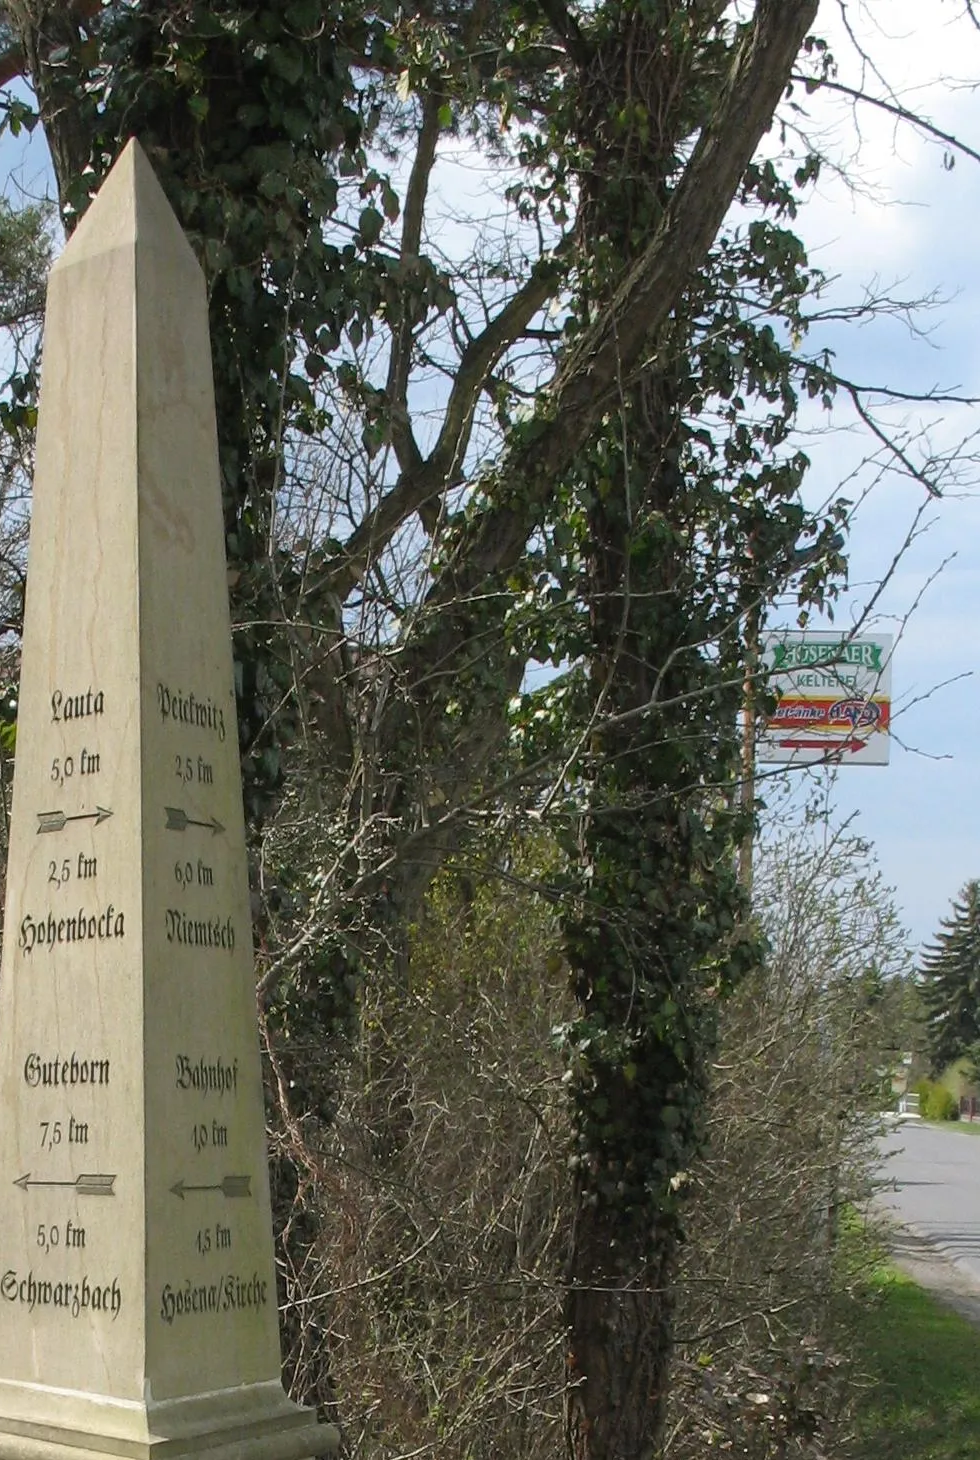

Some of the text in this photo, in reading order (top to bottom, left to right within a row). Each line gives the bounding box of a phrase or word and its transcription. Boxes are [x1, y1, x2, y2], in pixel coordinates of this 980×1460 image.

[50, 686, 105, 724] Lauta
[157, 683, 226, 742] Peickwitz
[51, 747, 101, 788] 5,0 km
[175, 755, 214, 786] 2,5 km
[48, 851, 98, 890] 2,5 km
[175, 857, 214, 890] 6,0 km
[19, 904, 125, 955] Hohenbocka
[24, 1051, 110, 1087] Guteborn
[175, 1054, 239, 1098] Bahnhof
[39, 1116, 89, 1151] 7,5 km
[192, 1118, 228, 1153] 1,0 km
[36, 1219, 86, 1254] 5,0 km
[196, 1219, 232, 1257] 1,5 km
[0, 1269, 121, 1321] Schwarzbach
